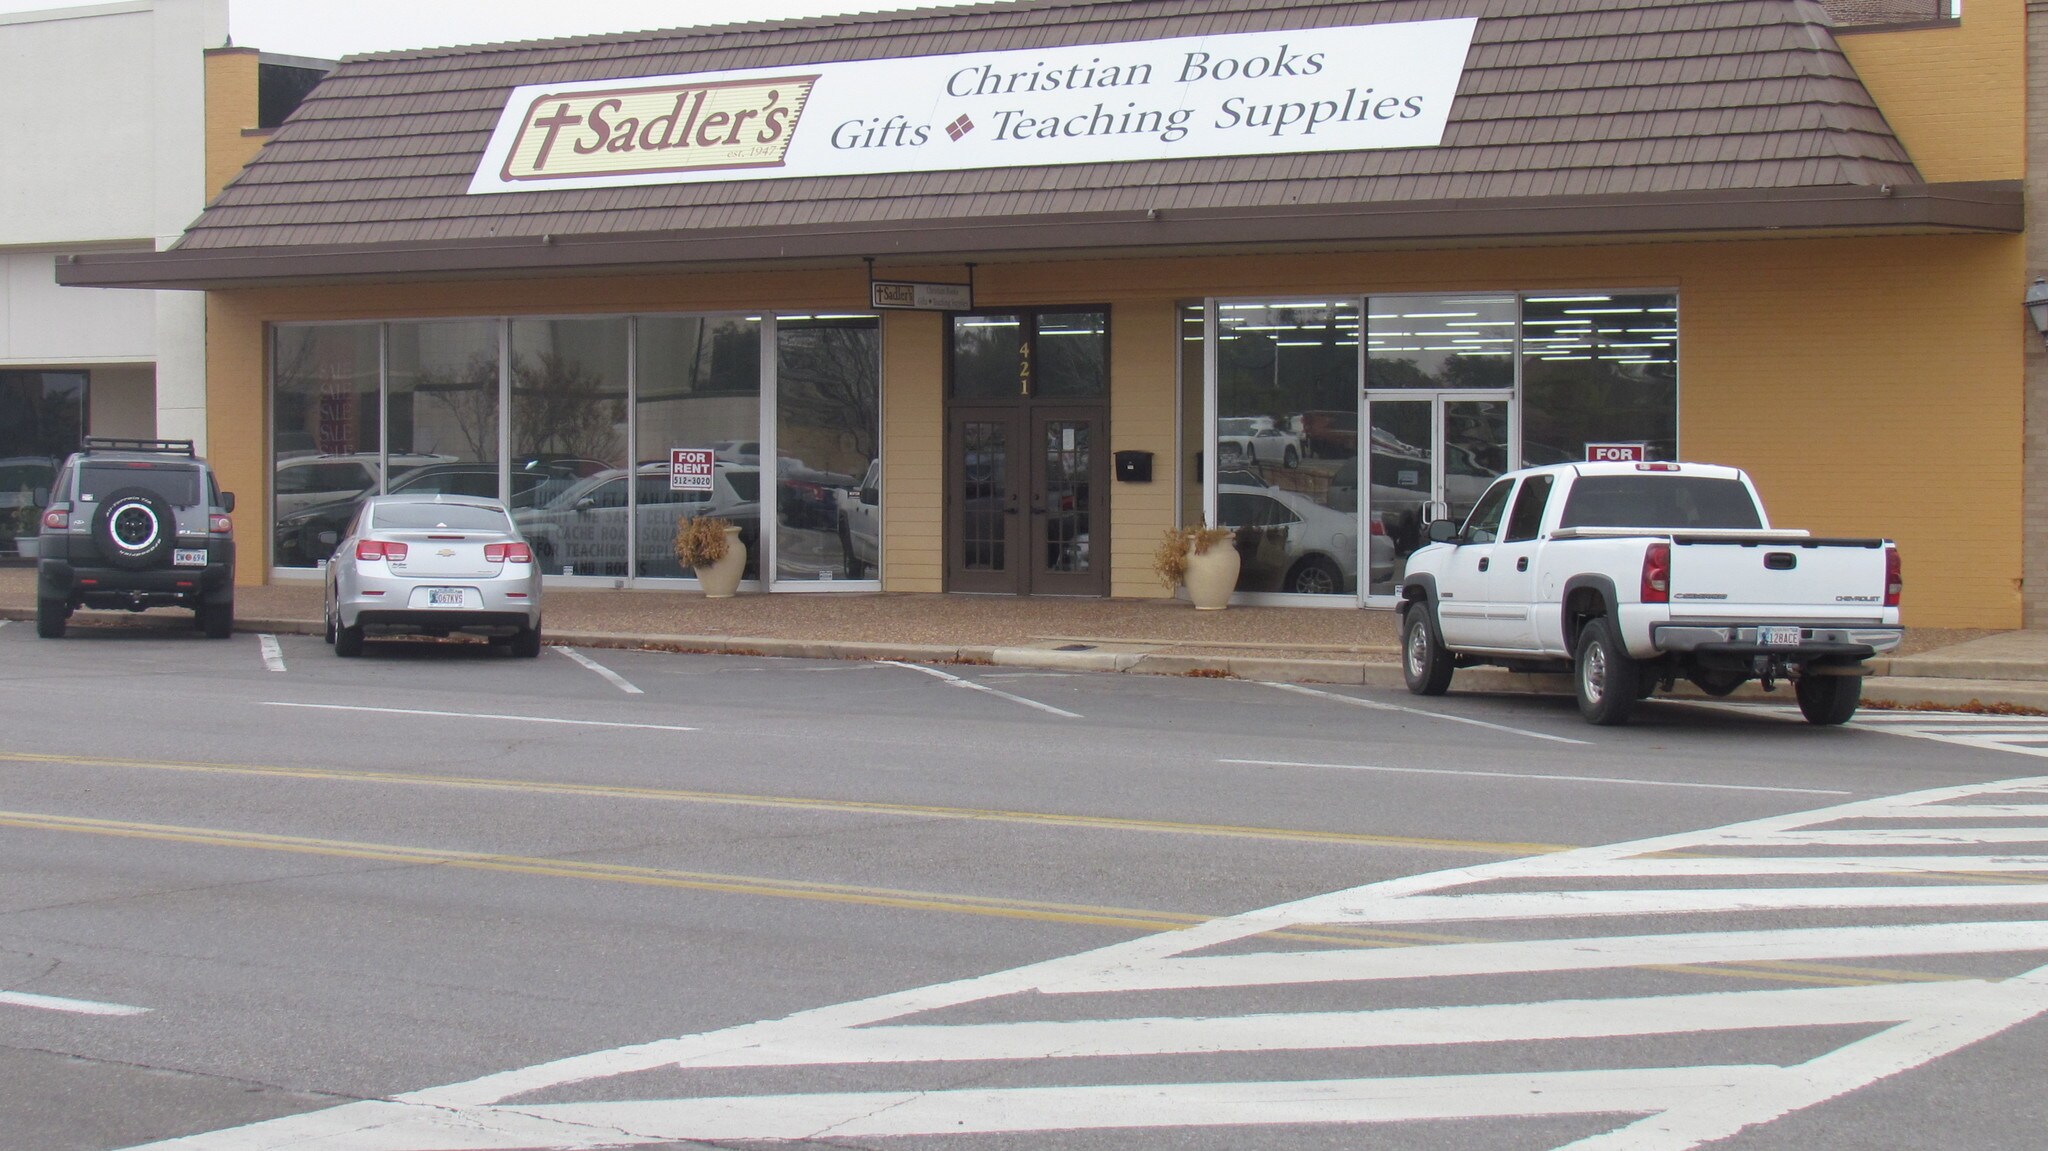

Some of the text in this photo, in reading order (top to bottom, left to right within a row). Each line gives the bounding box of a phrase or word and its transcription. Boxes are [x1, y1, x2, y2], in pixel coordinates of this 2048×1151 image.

[946, 44, 1325, 98] Christian Books
[573, 89, 789, 154] Sadler's
[830, 89, 1424, 149] Gifts Teaching Supplies
[750, 145, 777, 157] 1947
[883, 285, 913, 301] Sadler's
[678, 452, 706, 463] FOR
[1596, 448, 1633, 460] FOR
[674, 463, 710, 474] RENT
[674, 476, 710, 485] 512-3020
[1769, 633, 1798, 644] 128ACE
